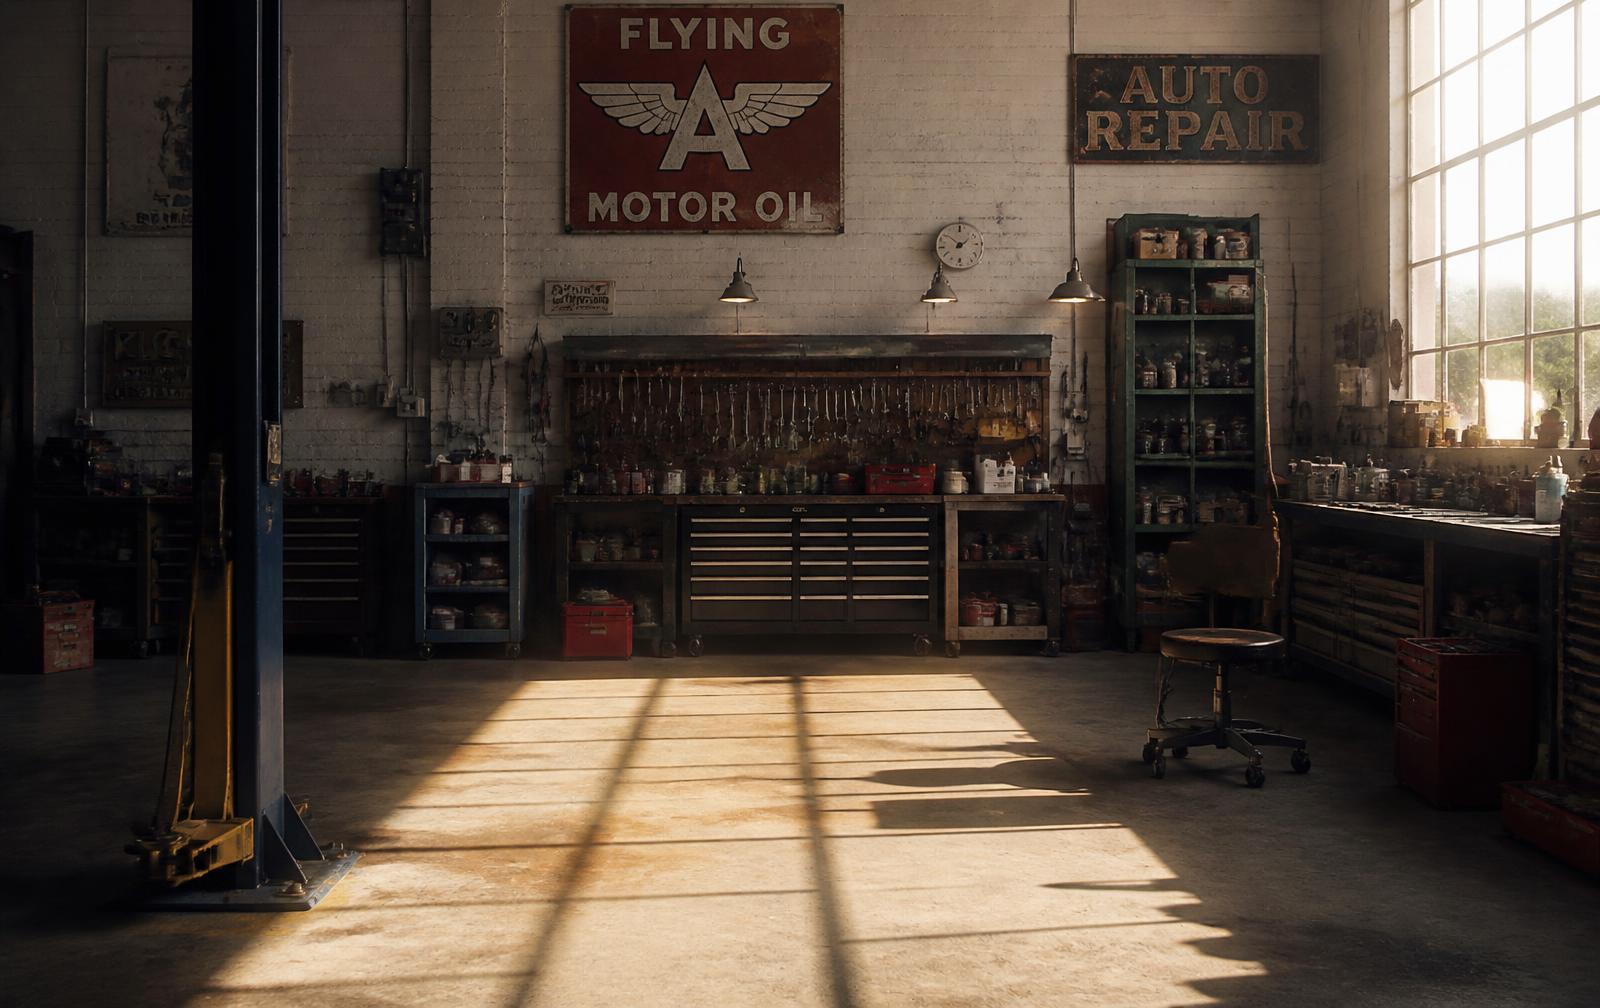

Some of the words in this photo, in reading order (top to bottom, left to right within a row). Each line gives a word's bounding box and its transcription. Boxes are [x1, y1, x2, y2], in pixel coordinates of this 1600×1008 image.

[620, 17, 790, 50] FLYING
[1119, 65, 1269, 105] AUTO
[658, 60, 751, 171] A
[1086, 110, 1309, 151] REPAIR
[588, 191, 737, 222] MOTOR
[755, 191, 824, 222] OIL
